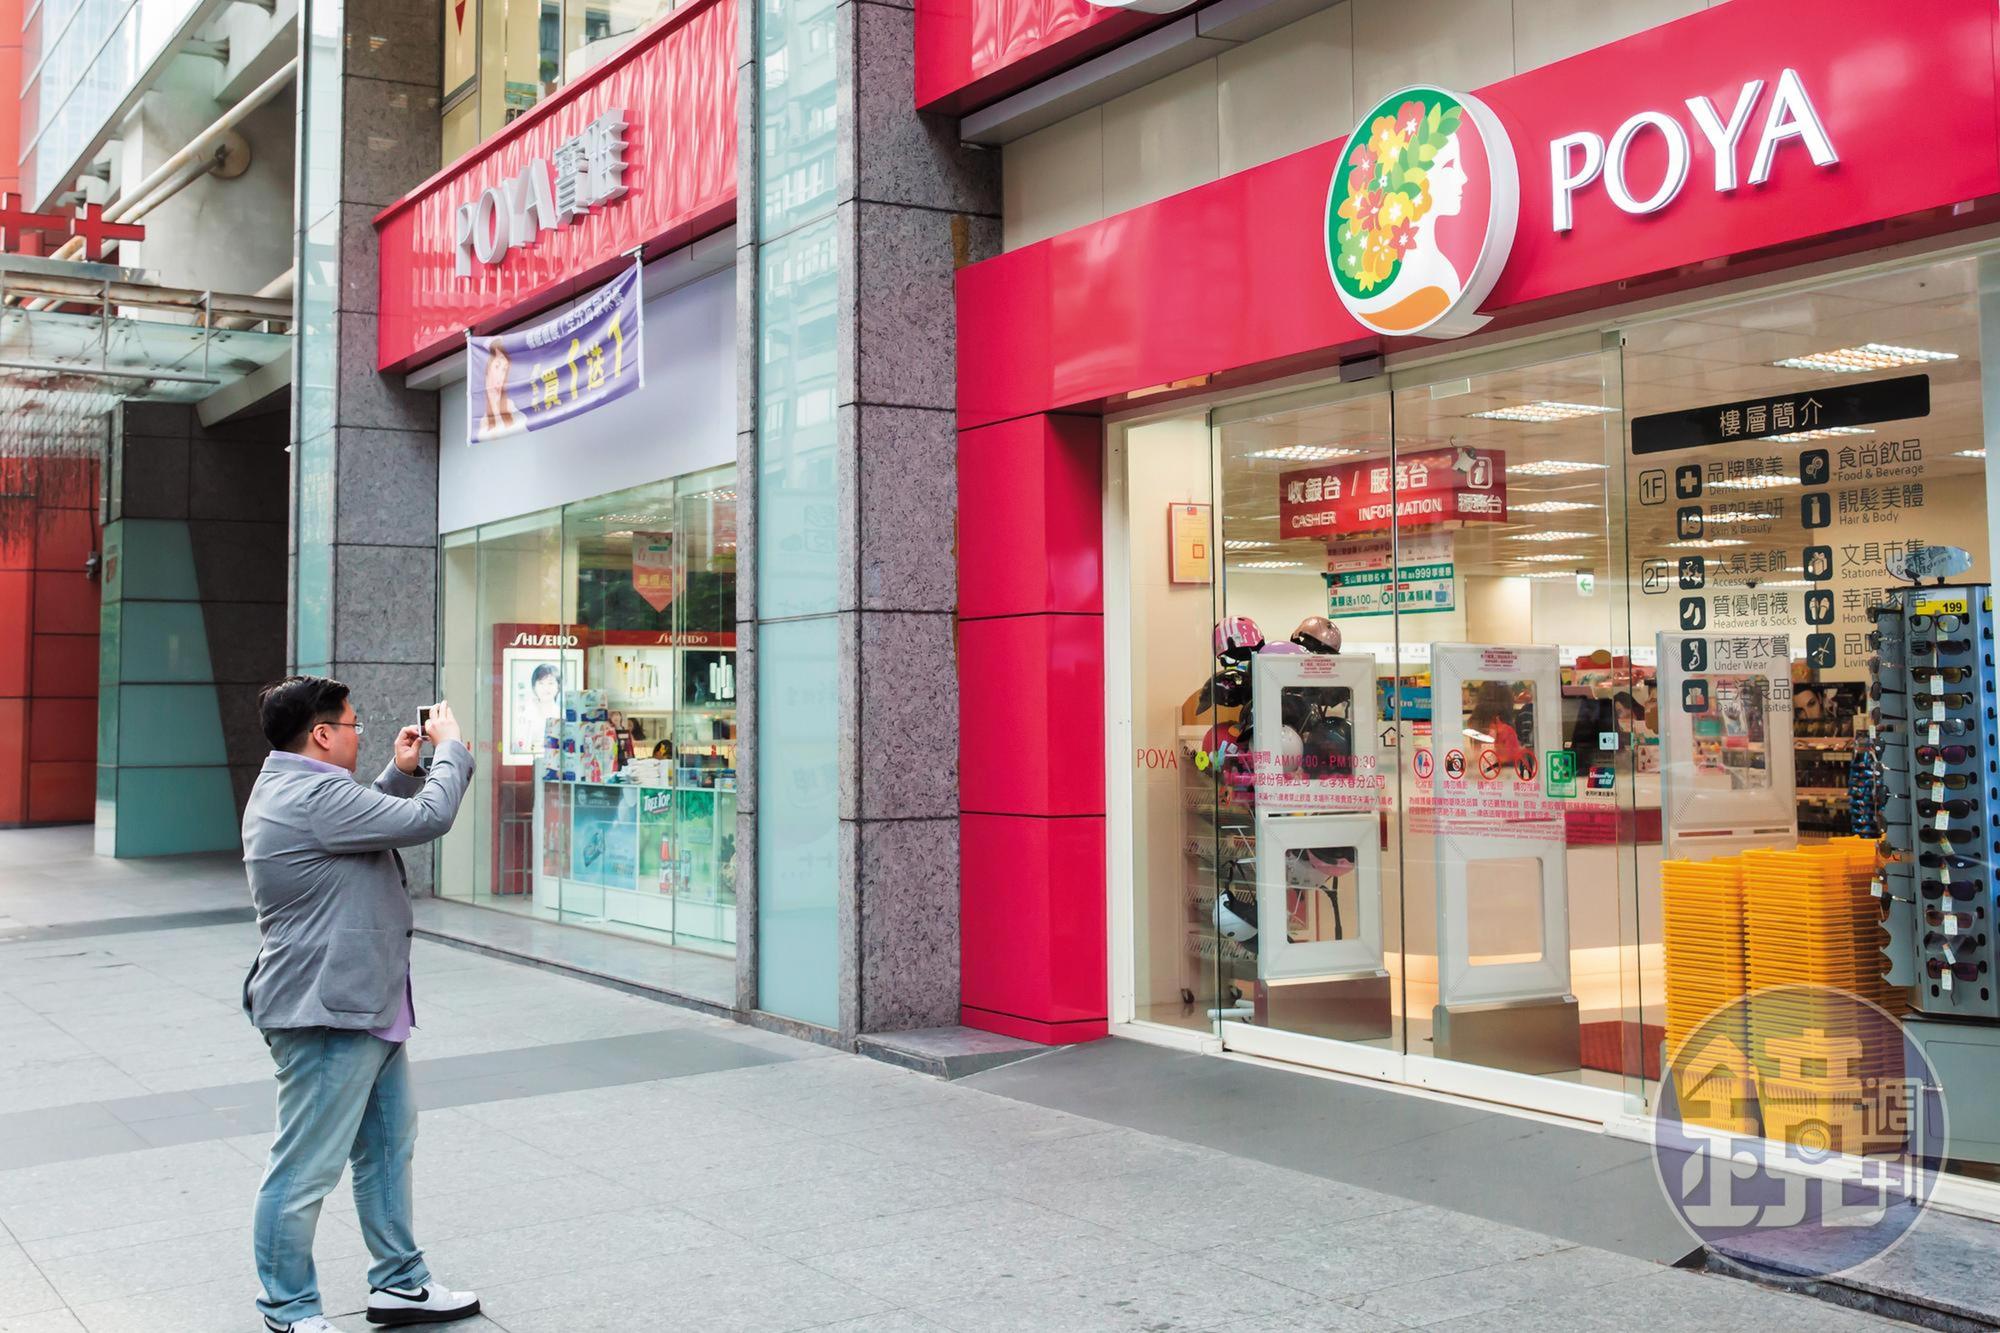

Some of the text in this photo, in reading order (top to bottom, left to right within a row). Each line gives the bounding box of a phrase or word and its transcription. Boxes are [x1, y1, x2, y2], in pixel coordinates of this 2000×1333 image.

[1550, 68, 1839, 232] POYA
[1719, 397, 1823, 437] 樓層簡介
[1837, 438, 1922, 470] 食尚飲品
[1707, 455, 1784, 483] 品牌醫美
[1838, 464, 1923, 482] Food & Beverage
[1287, 475, 1341, 505] 收銀台
[1370, 462, 1428, 494] 服務台
[1642, 477, 1663, 499] 1F
[1358, 498, 1443, 522] INFORMATION
[1839, 483, 1924, 514] 靚髮美體
[1839, 510, 1899, 525] Hair & Body
[1710, 526, 1729, 537] Skin
[1740, 523, 1772, 535] Beauty
[1713, 550, 1787, 577] 人氣美飾
[1841, 539, 1926, 567] 文具市集
[1645, 566, 1666, 588] 2F
[1713, 592, 1789, 618] 質優帽襪
[1943, 602, 1962, 613] 199
[1713, 616, 1797, 629] Headwear & Socks
[510, 632, 578, 647] SHISEIDO
[1714, 635, 1790, 659] 內著衣賞
[1714, 660, 1767, 671] Under Wear
[1716, 678, 1791, 702] 生活良品
[1137, 749, 1178, 769] POYA
